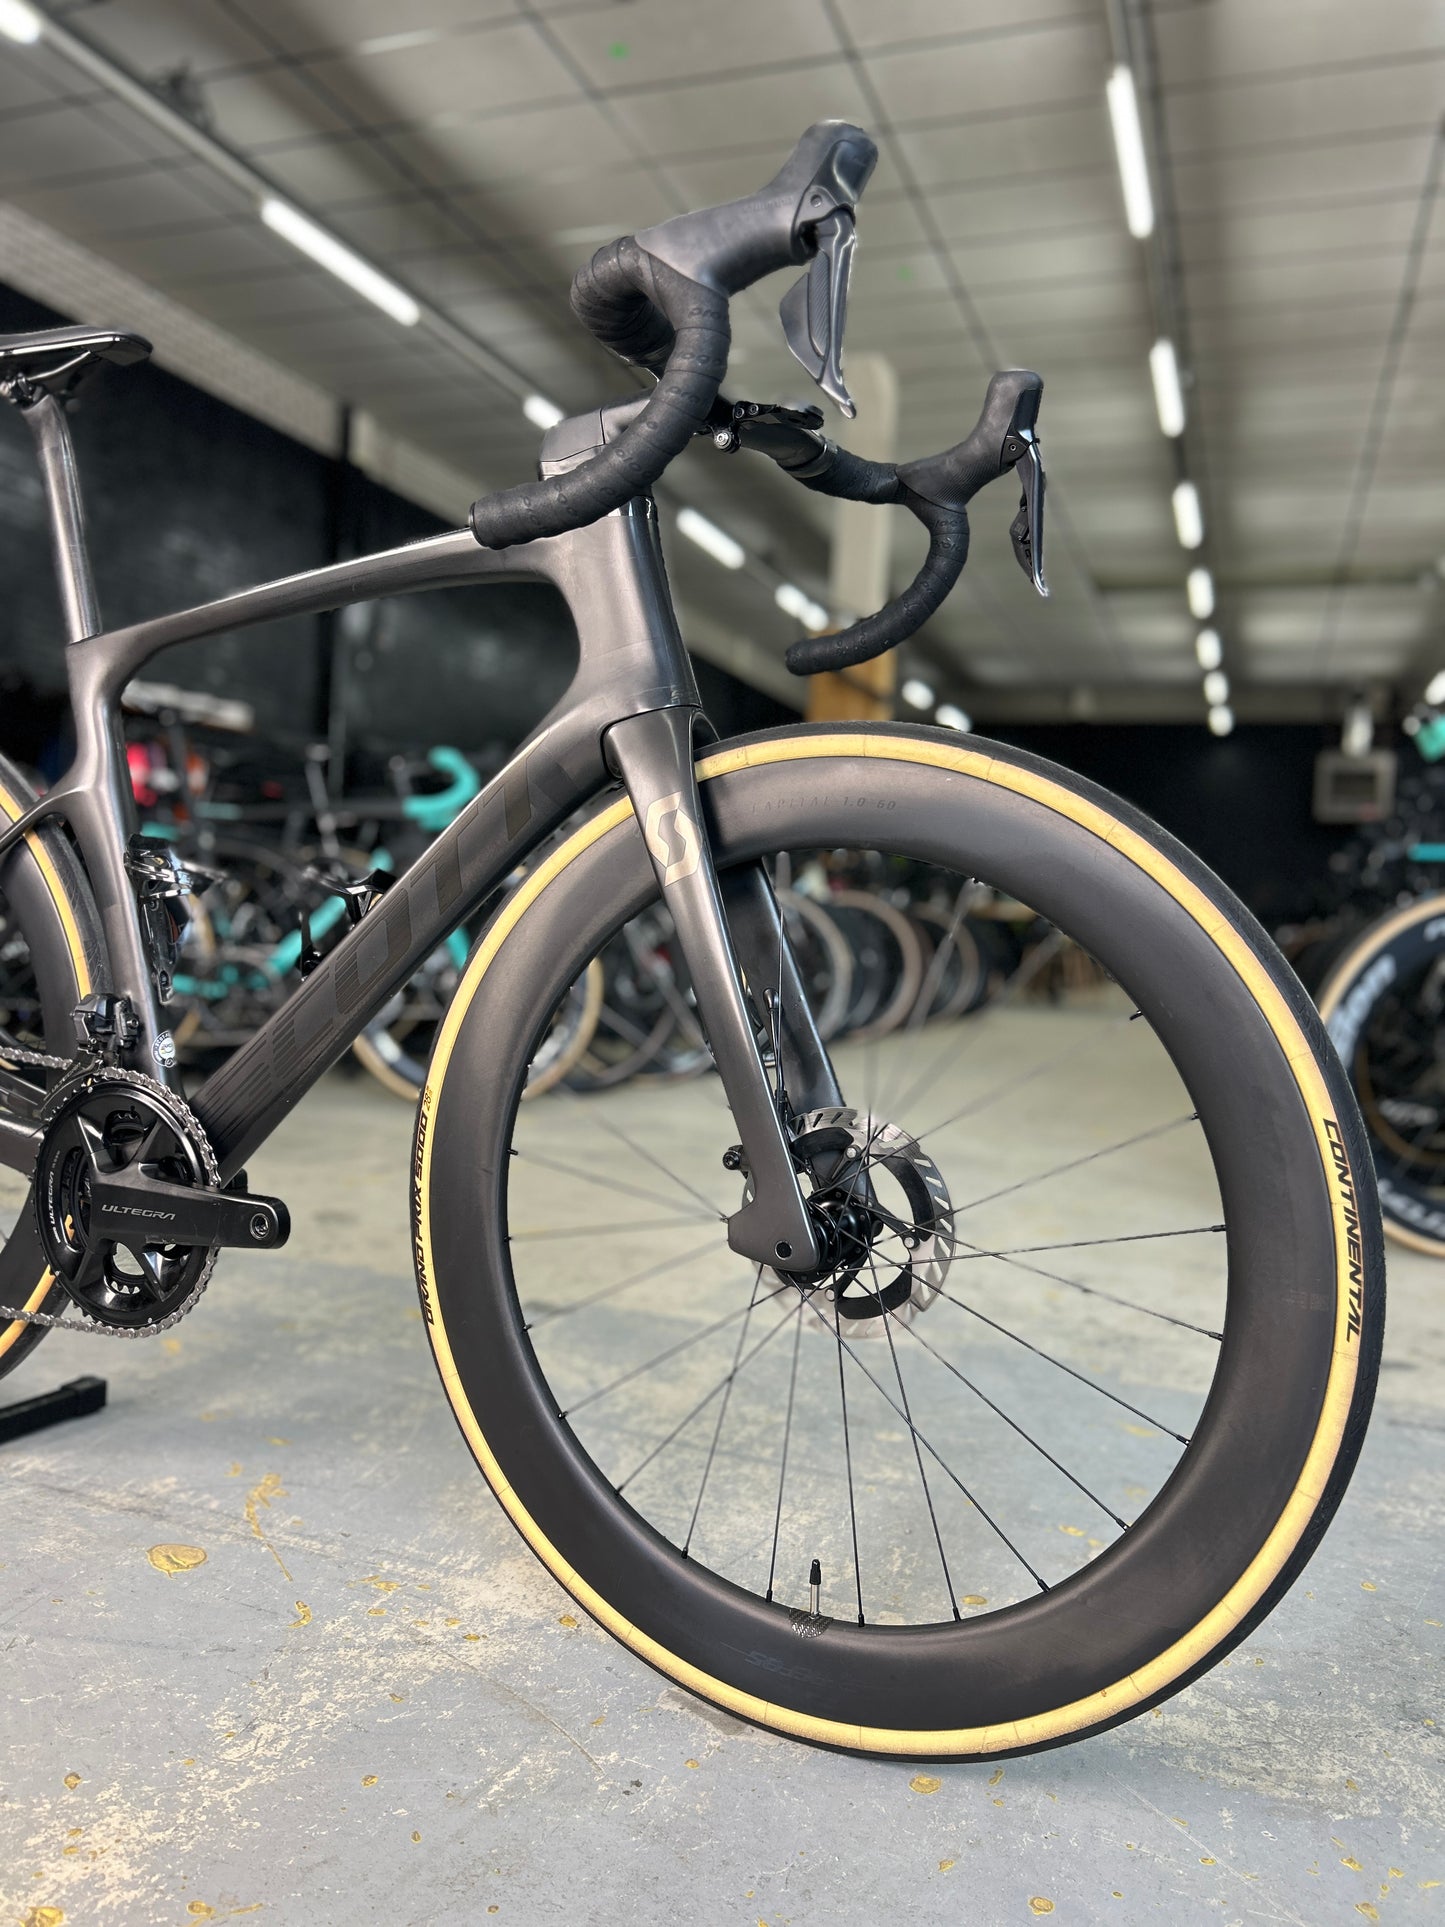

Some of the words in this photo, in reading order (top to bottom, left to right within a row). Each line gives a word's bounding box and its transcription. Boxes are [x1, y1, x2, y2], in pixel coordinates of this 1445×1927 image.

[843, 796, 866, 808] 1.0
[876, 799, 897, 811] 60
[415, 1115, 428, 1182] 5000
[48, 1170, 56, 1225] ULTEGRA
[101, 1204, 176, 1221] ULTEGRA
[412, 1178, 423, 1242] PRIX
[1323, 1117, 1365, 1343] CONTINENTAL
[415, 1246, 435, 1326] GRAND
